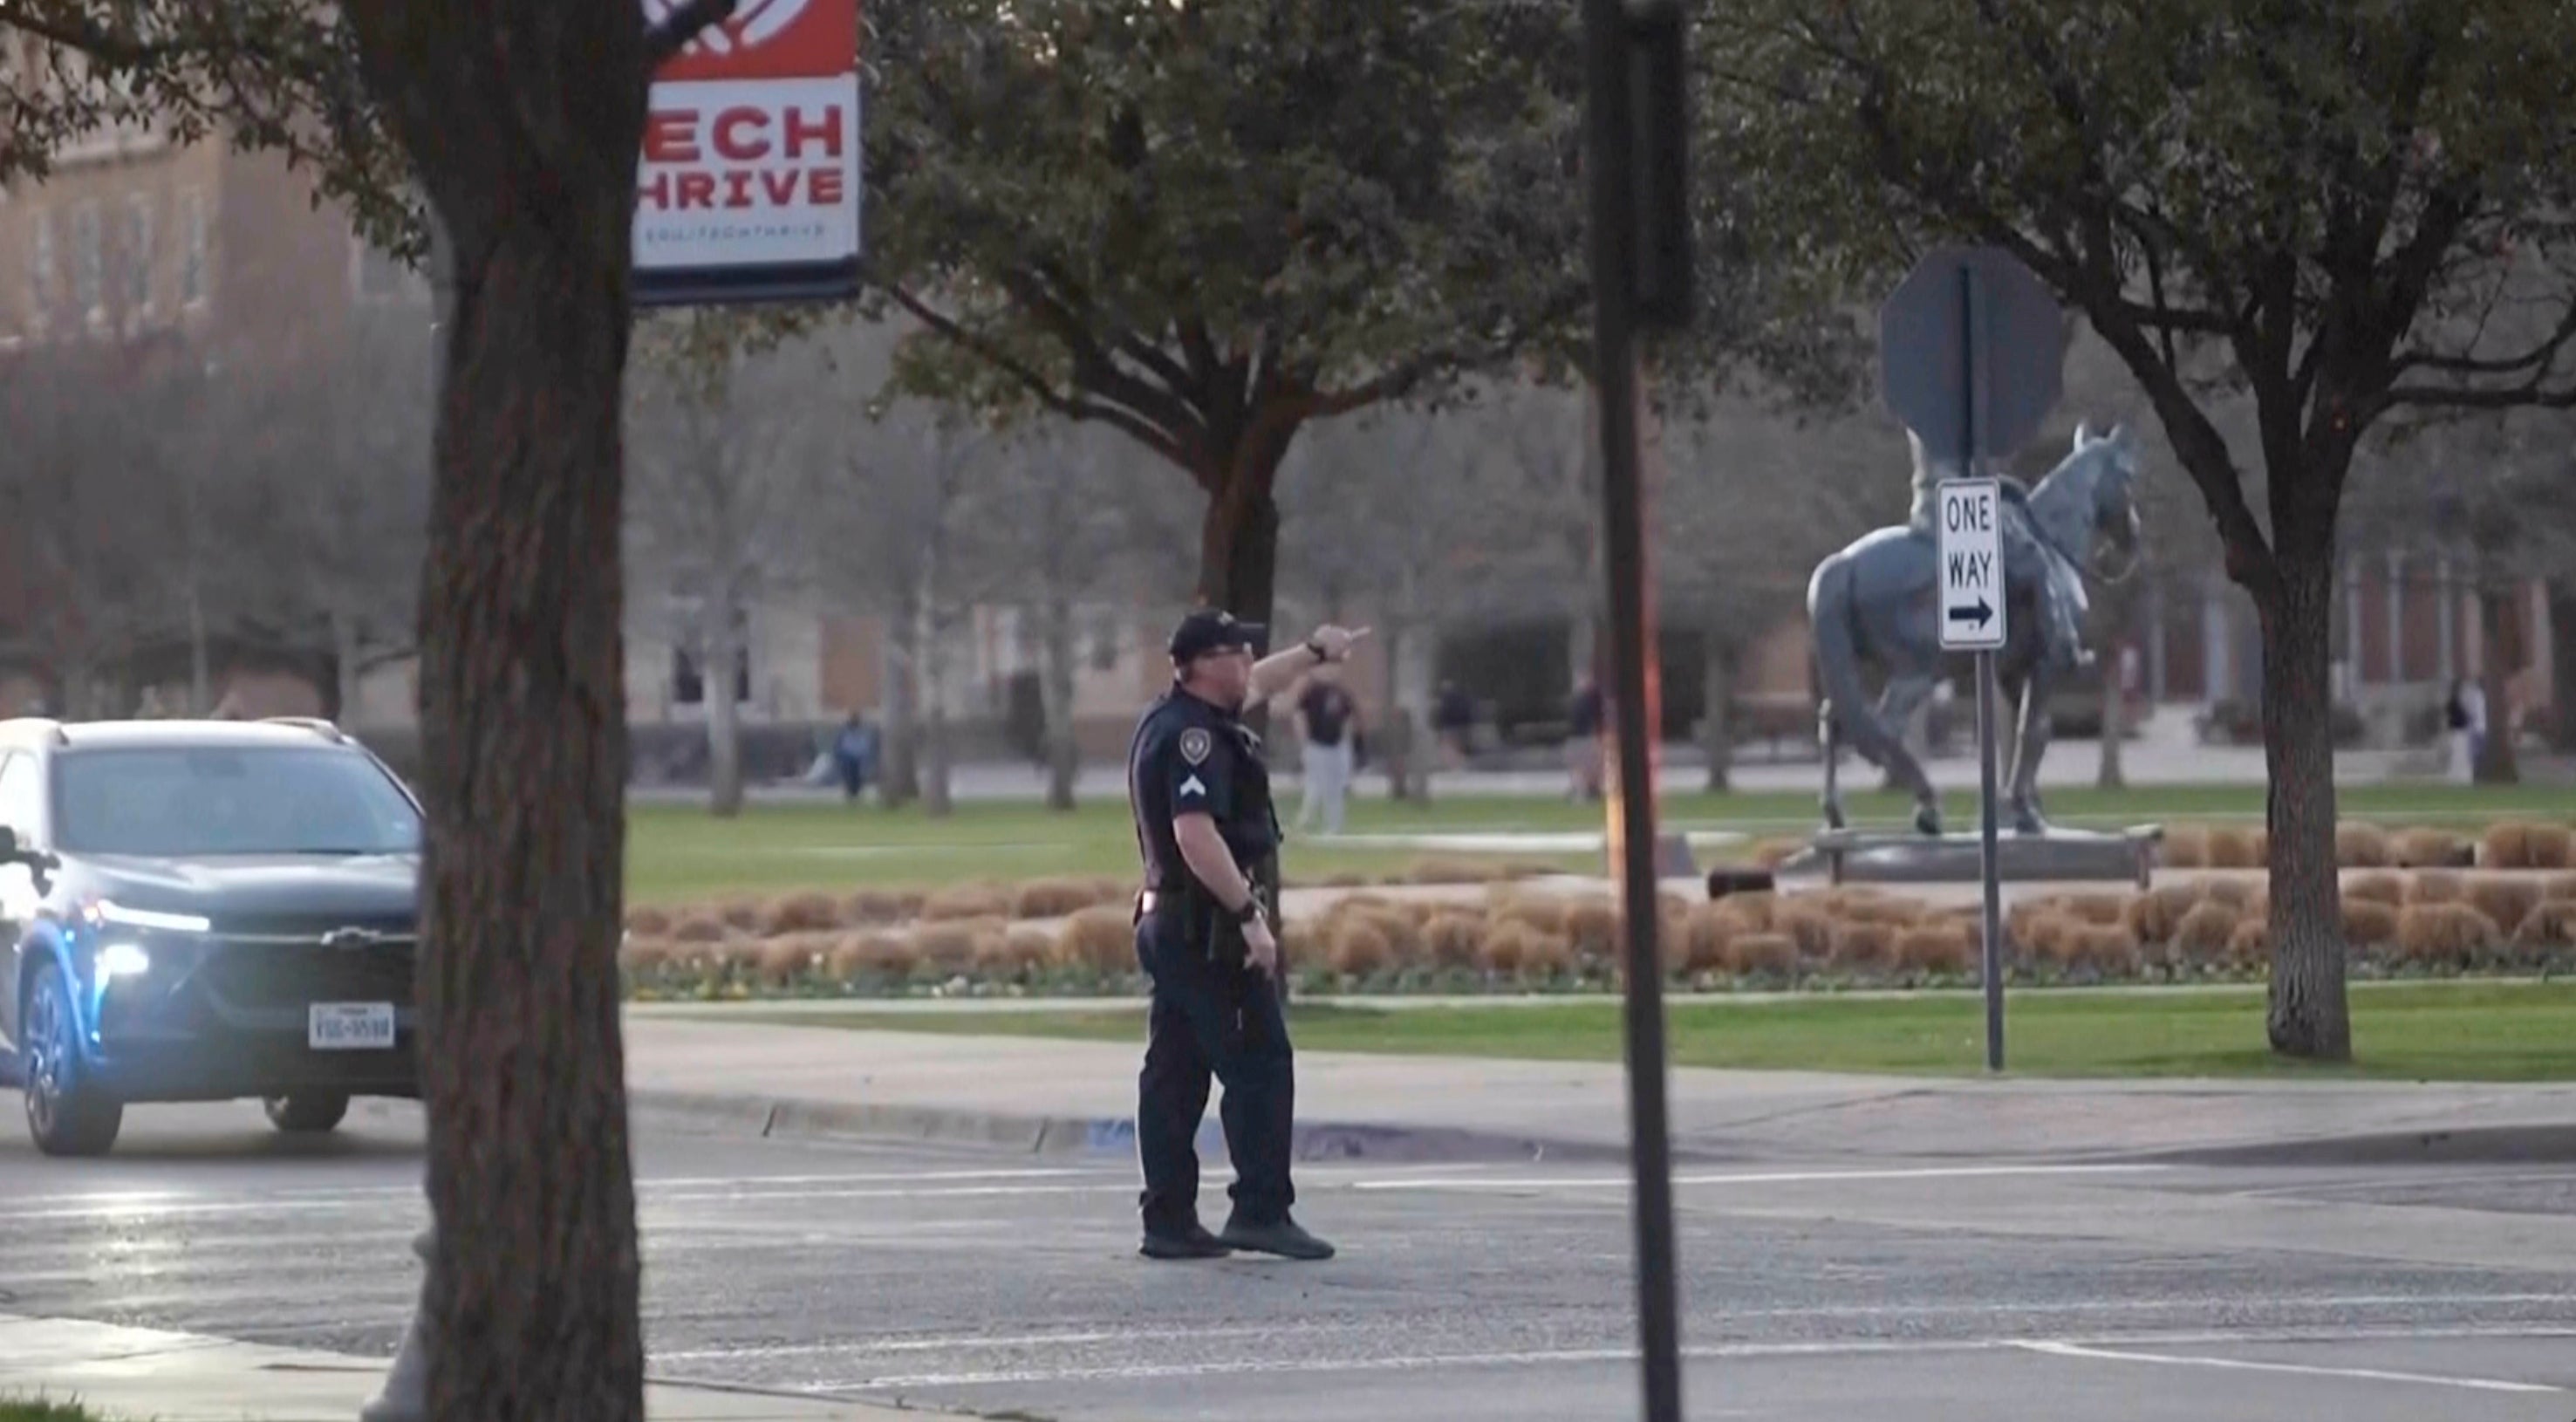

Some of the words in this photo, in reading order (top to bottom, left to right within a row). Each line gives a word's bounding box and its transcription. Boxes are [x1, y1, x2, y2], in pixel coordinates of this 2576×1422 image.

[645, 106, 842, 162] ECH
[638, 168, 843, 210] HRIVE
[1947, 496, 1990, 532] ONE
[1949, 550, 1992, 589] WAY
